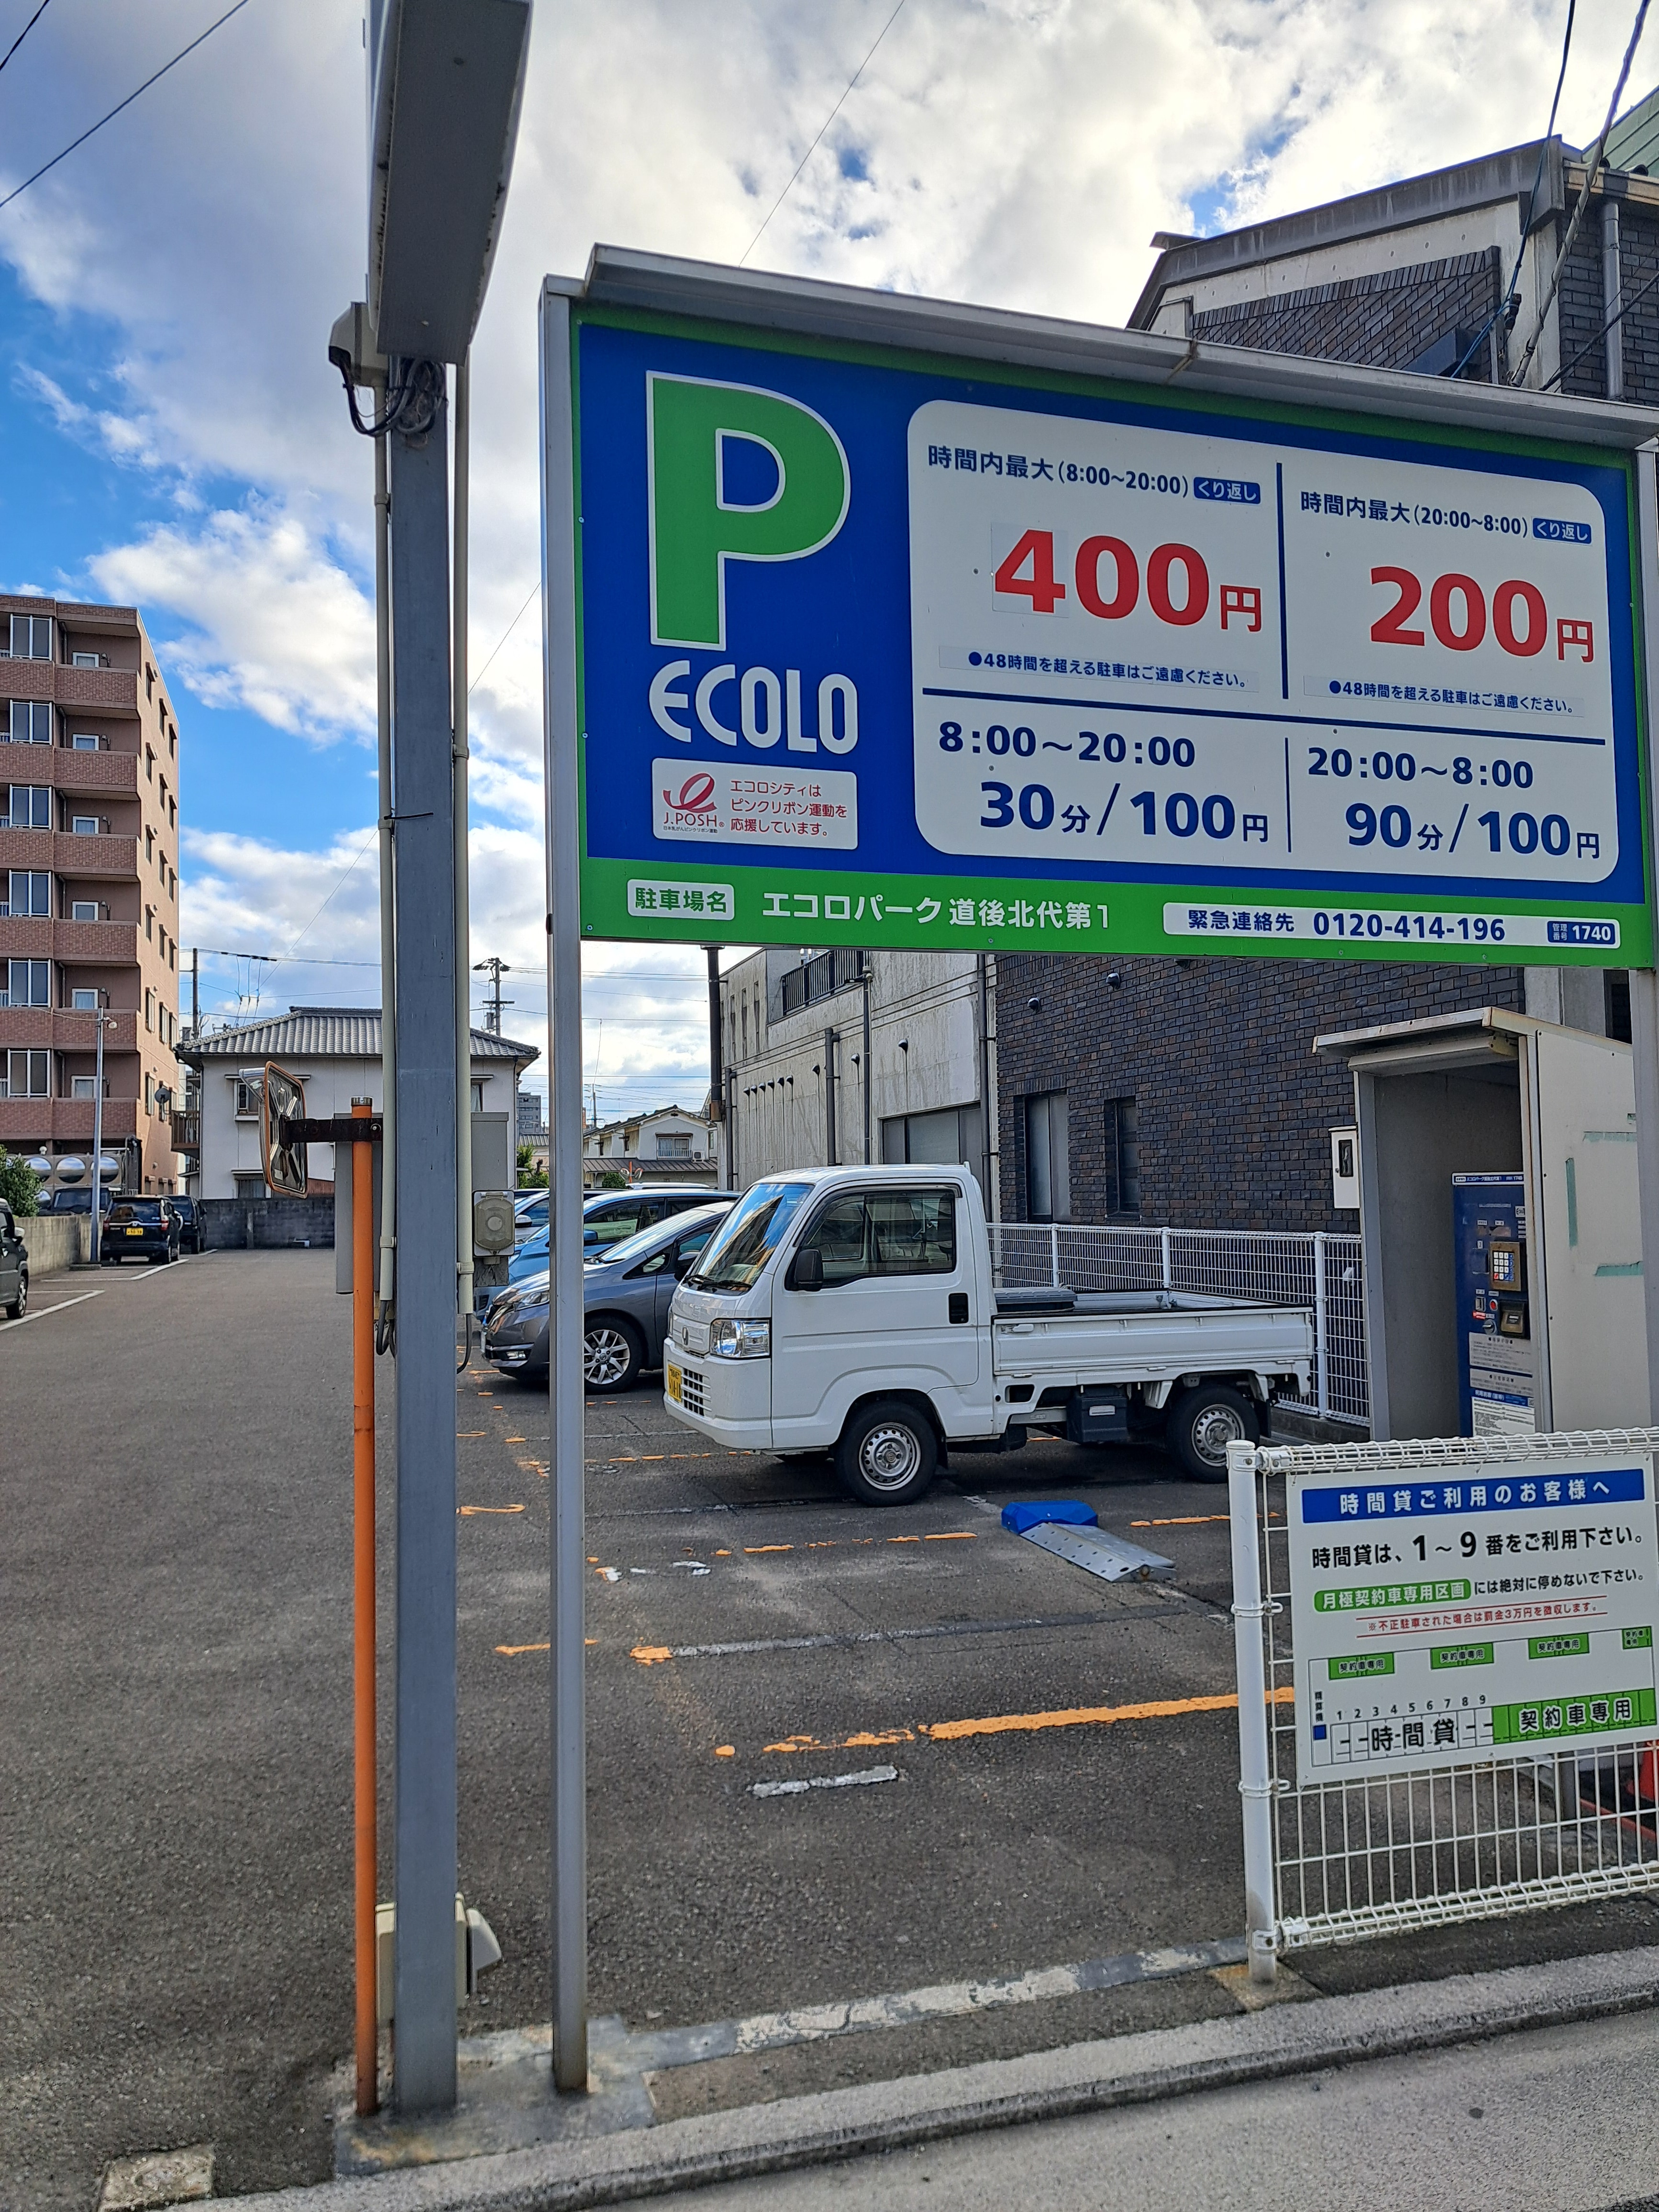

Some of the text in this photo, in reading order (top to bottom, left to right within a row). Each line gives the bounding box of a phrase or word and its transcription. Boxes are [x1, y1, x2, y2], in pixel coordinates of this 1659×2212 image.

[1198, 480, 1257, 500] くり返し
[646, 370, 851, 651] P
[1537, 522, 1588, 541] くり返し
[995, 529, 1262, 632] 400円
[1370, 566, 1594, 663] 200円
[649, 660, 858, 754] ECOLO
[730, 780, 821, 798] エコロシティは
[731, 798, 847, 818] ピンクリボン運動を
[731, 818, 828, 837] 応援しています。
[635, 887, 727, 913] 駐車場名
[1188, 910, 1504, 940] 緊急連絡先 0120-414-196
[1572, 925, 1611, 940] 1740
[1340, 1479, 1610, 1514] 時間貸ご利用のお客様へ
[1323, 1569, 1644, 1610] 月極契約車専用区画 には絶対に停めないで下さい。
[1337, 1695, 1485, 1720] 1 2 3 4 5 6 7 8 9
[1520, 1699, 1631, 1732] 契約車専用
[1371, 1718, 1455, 1751] 時間貸
